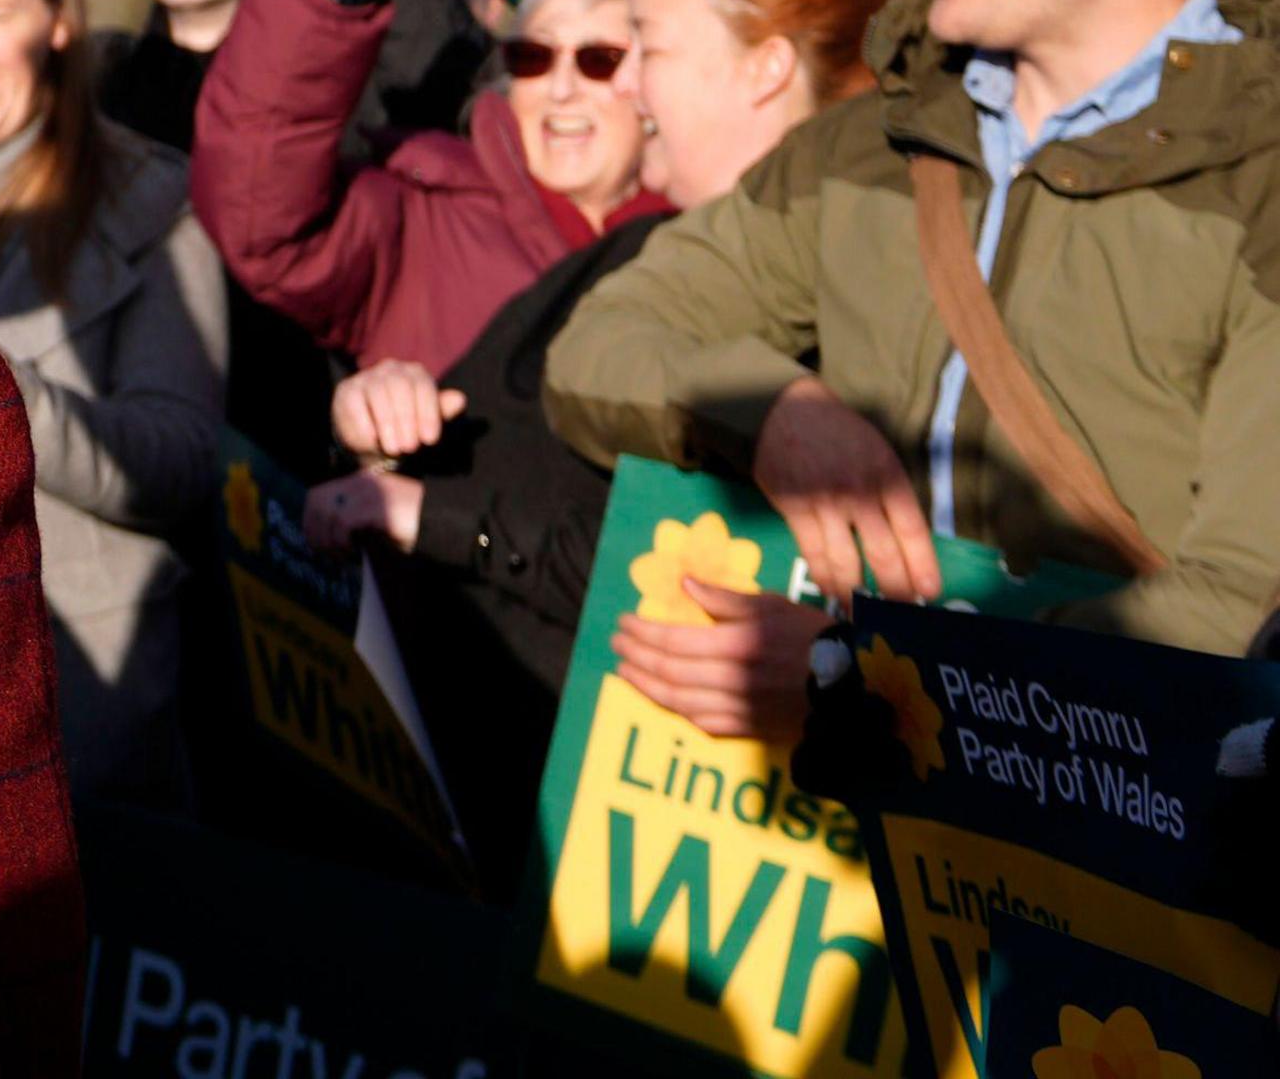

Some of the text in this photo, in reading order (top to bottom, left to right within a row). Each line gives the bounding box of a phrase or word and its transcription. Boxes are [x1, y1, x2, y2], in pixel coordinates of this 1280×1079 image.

[937, 662, 1149, 758] Plaid Cymru
[955, 727, 1187, 841] Party of Wales
[607, 808, 894, 1069] Wh
